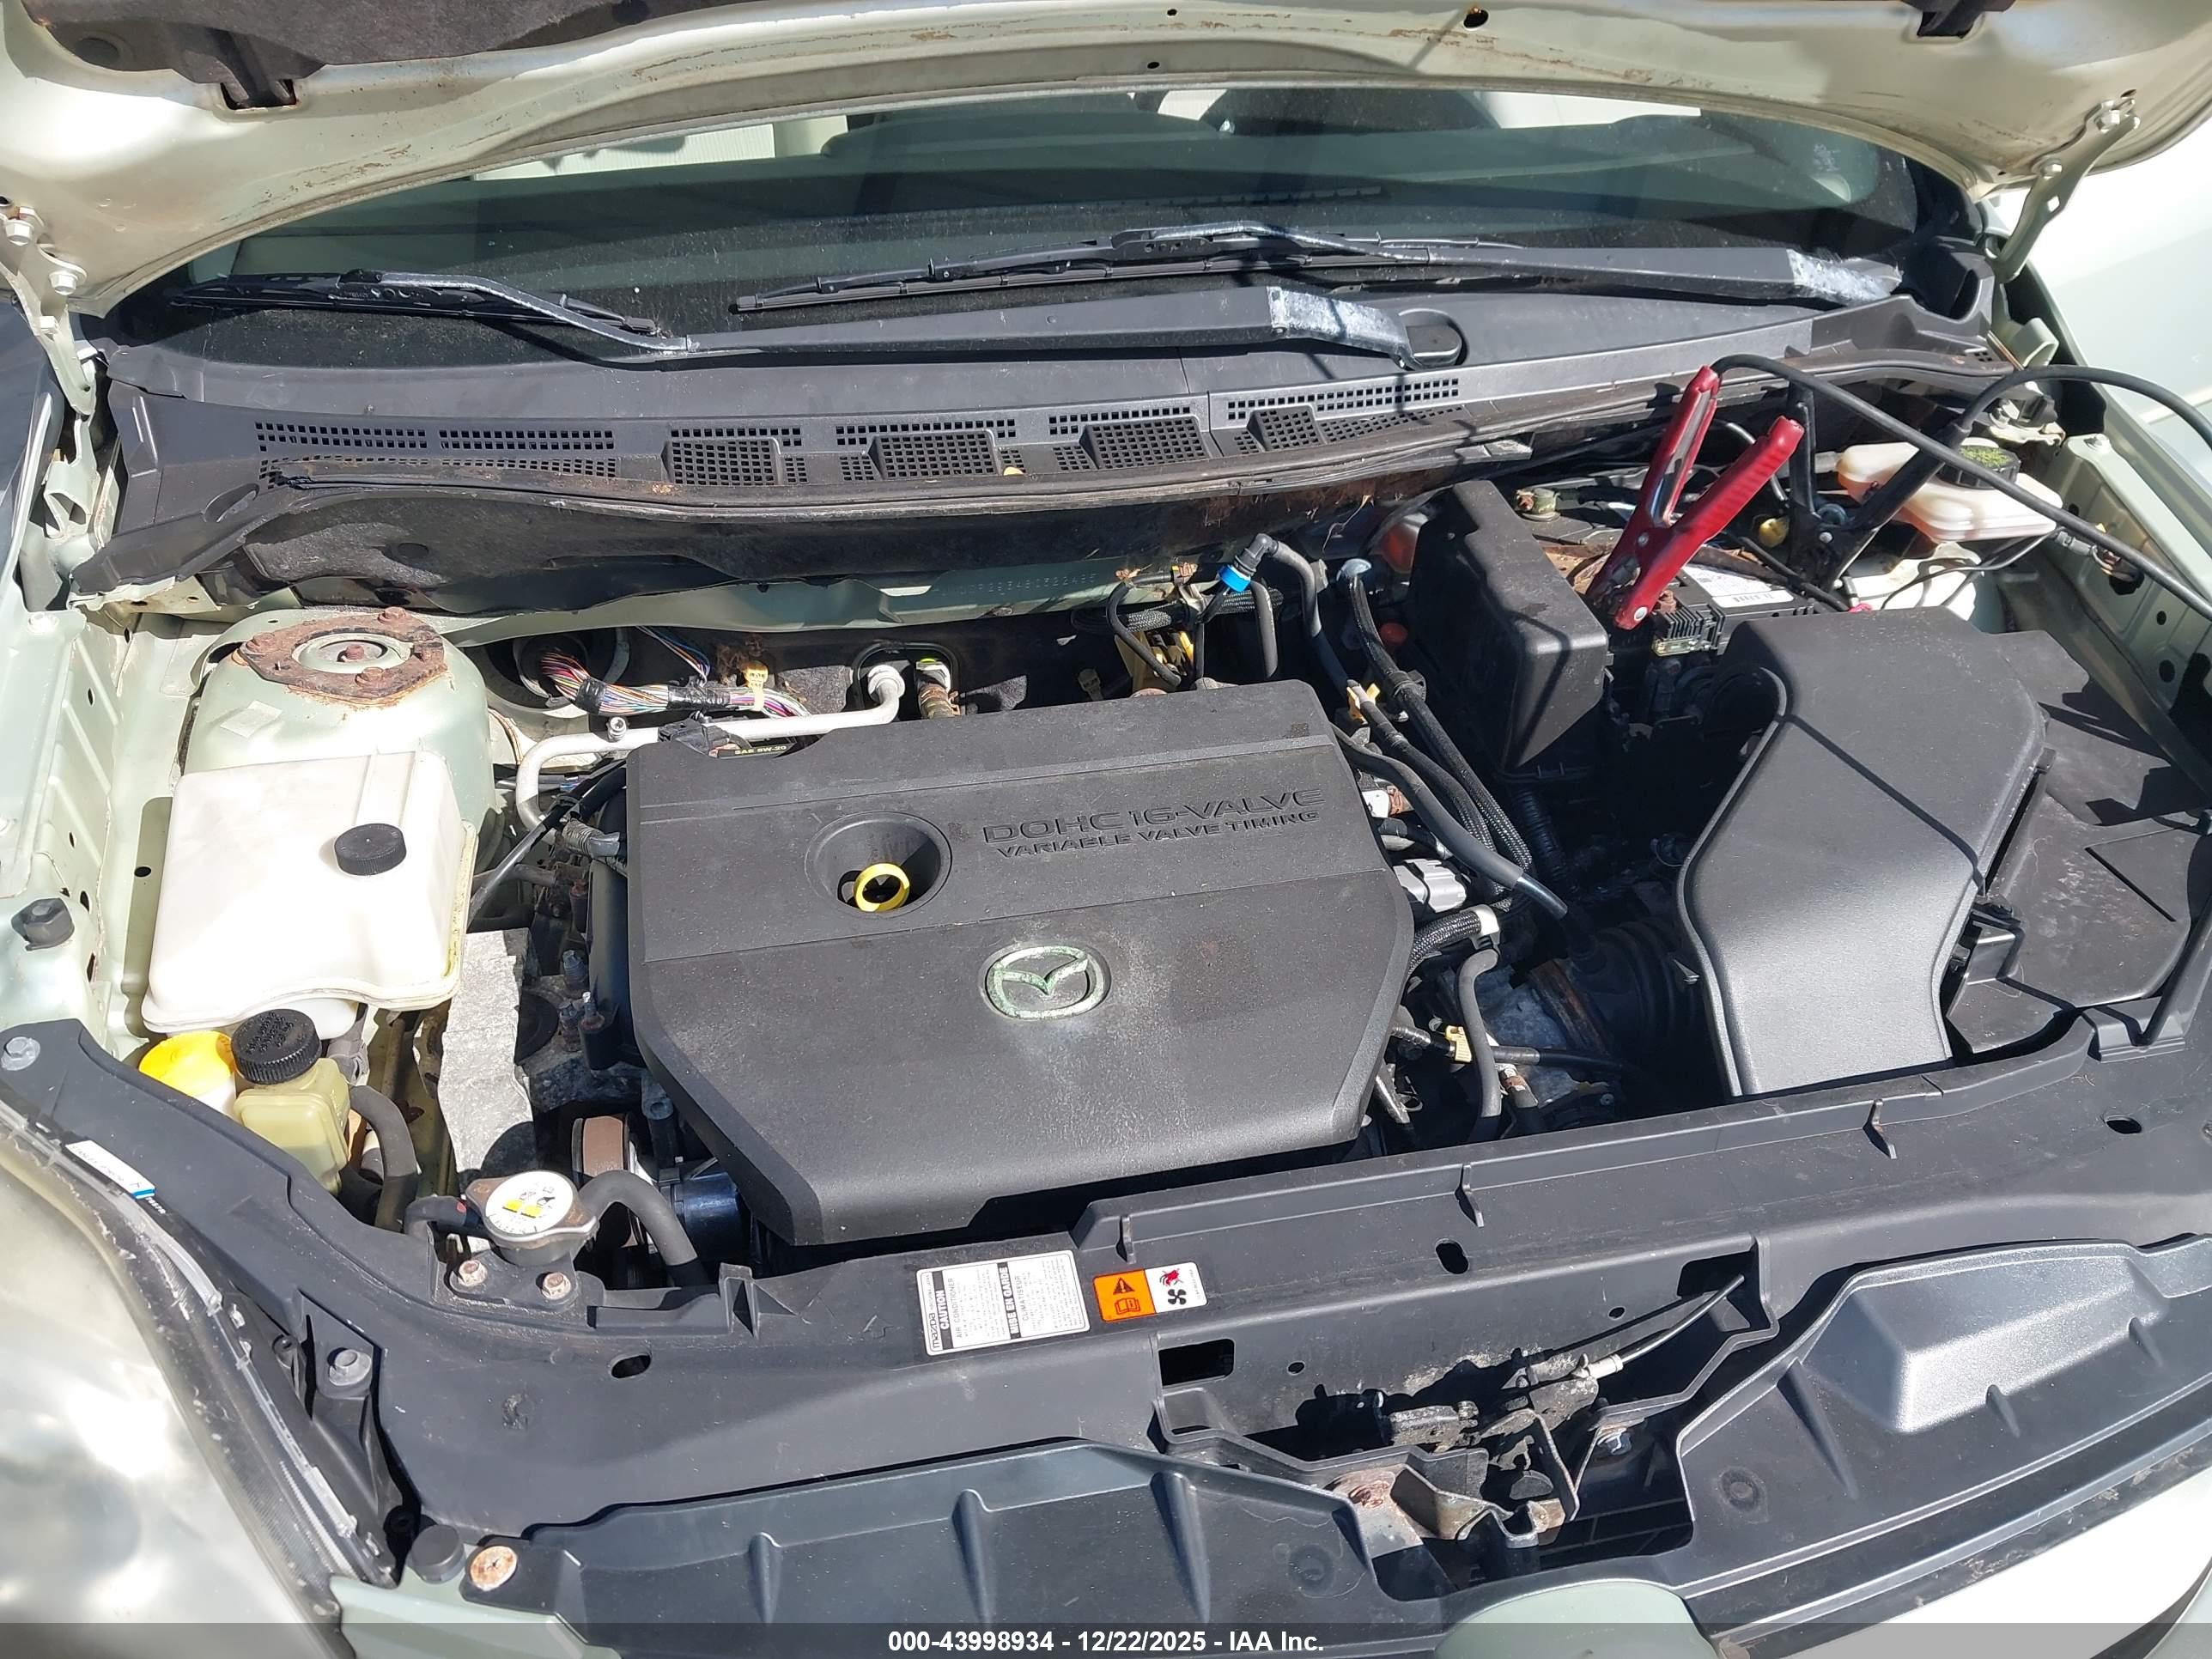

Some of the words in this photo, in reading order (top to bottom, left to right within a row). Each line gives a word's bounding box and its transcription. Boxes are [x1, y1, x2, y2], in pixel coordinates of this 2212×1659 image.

[982, 811, 1124, 843] DOHC
[1128, 788, 1326, 827] 16-VALVE
[995, 833, 1132, 858] VARIABLE
[1138, 824, 1220, 842] VALVE
[1224, 811, 1321, 834] TIMING
[947, 1278, 959, 1323] CONDITIONER
[999, 1267, 1012, 1297] GARDE
[1014, 1275, 1029, 1322] CLIMATISEUR
[935, 1290, 949, 1329] CAUTION
[1005, 1297, 1014, 1310] EN
[1007, 1312, 1018, 1334] MISE
